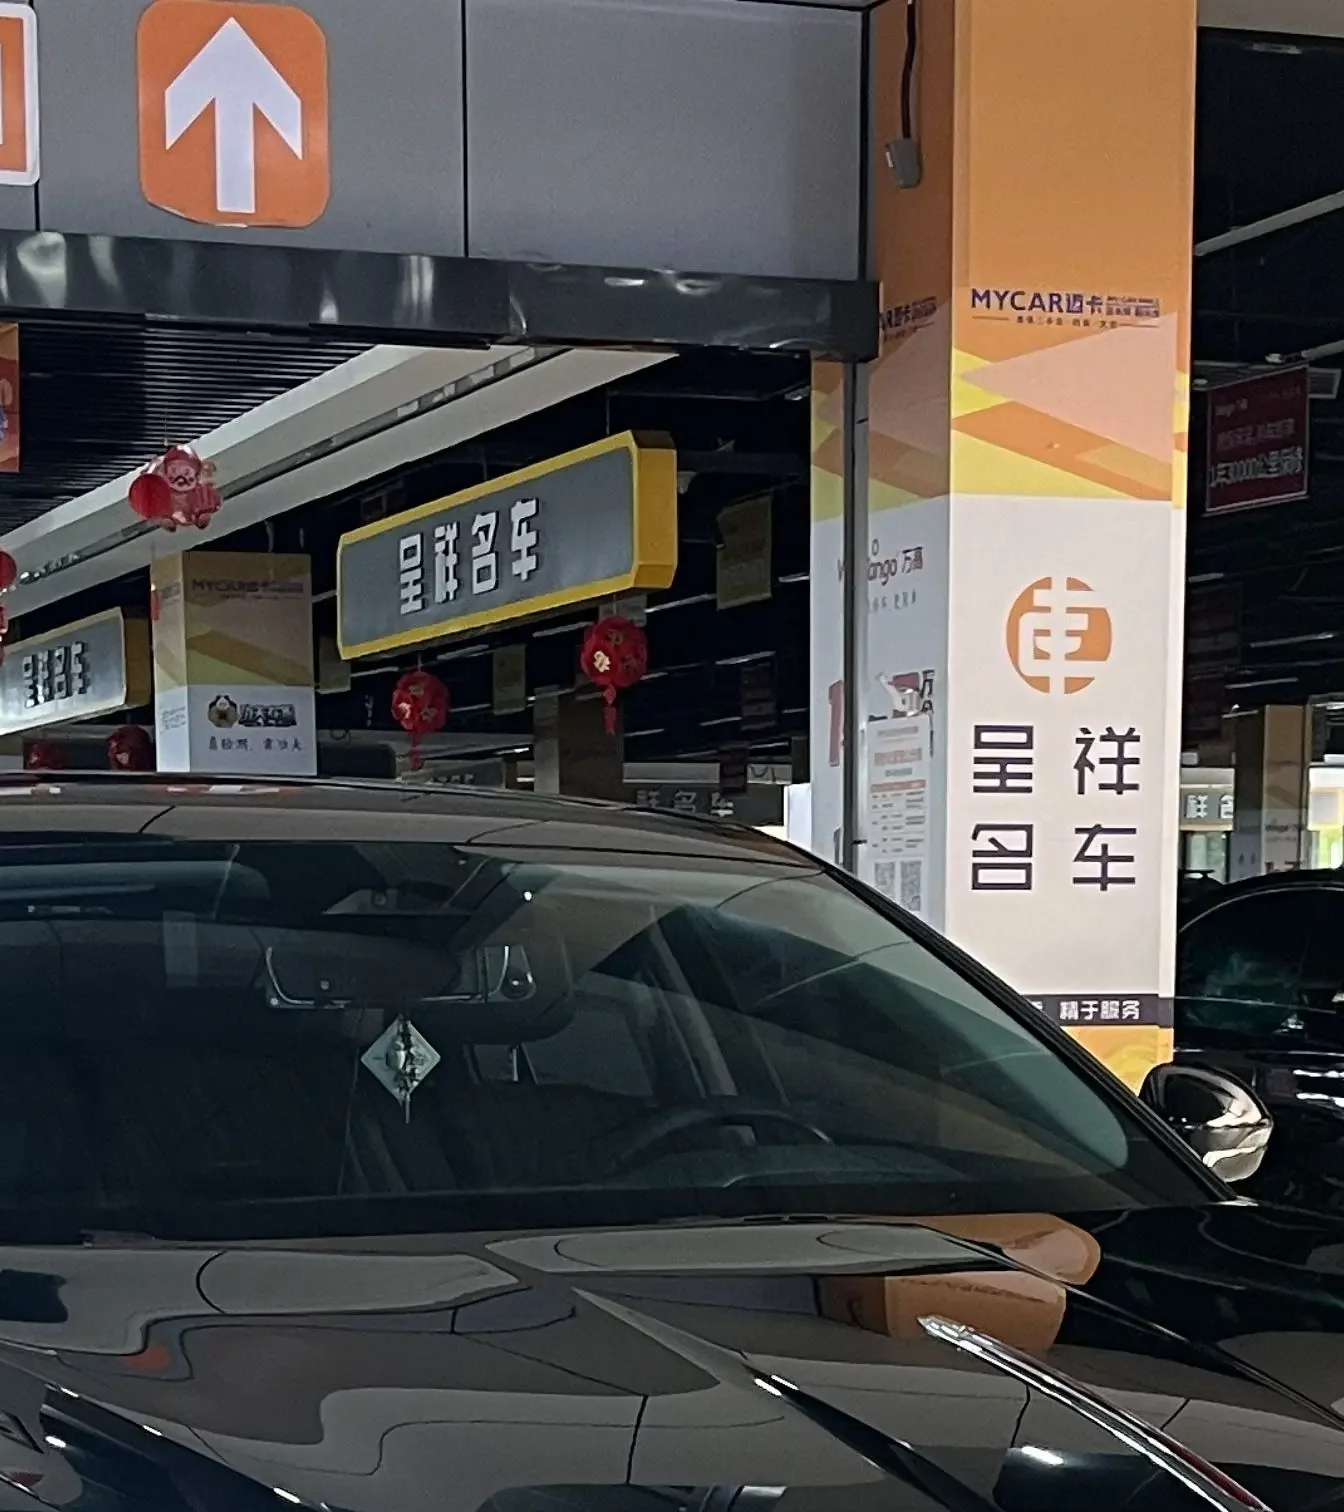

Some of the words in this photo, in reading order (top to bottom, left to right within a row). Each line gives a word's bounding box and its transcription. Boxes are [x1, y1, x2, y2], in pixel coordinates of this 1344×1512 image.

[971, 288, 1103, 315] MYCAR迈卡
[399, 497, 540, 616] 呈祥名车
[972, 724, 1141, 796] 呈祥
[971, 823, 1138, 892] 名车
[1059, 1000, 1140, 1020] 精于服务
